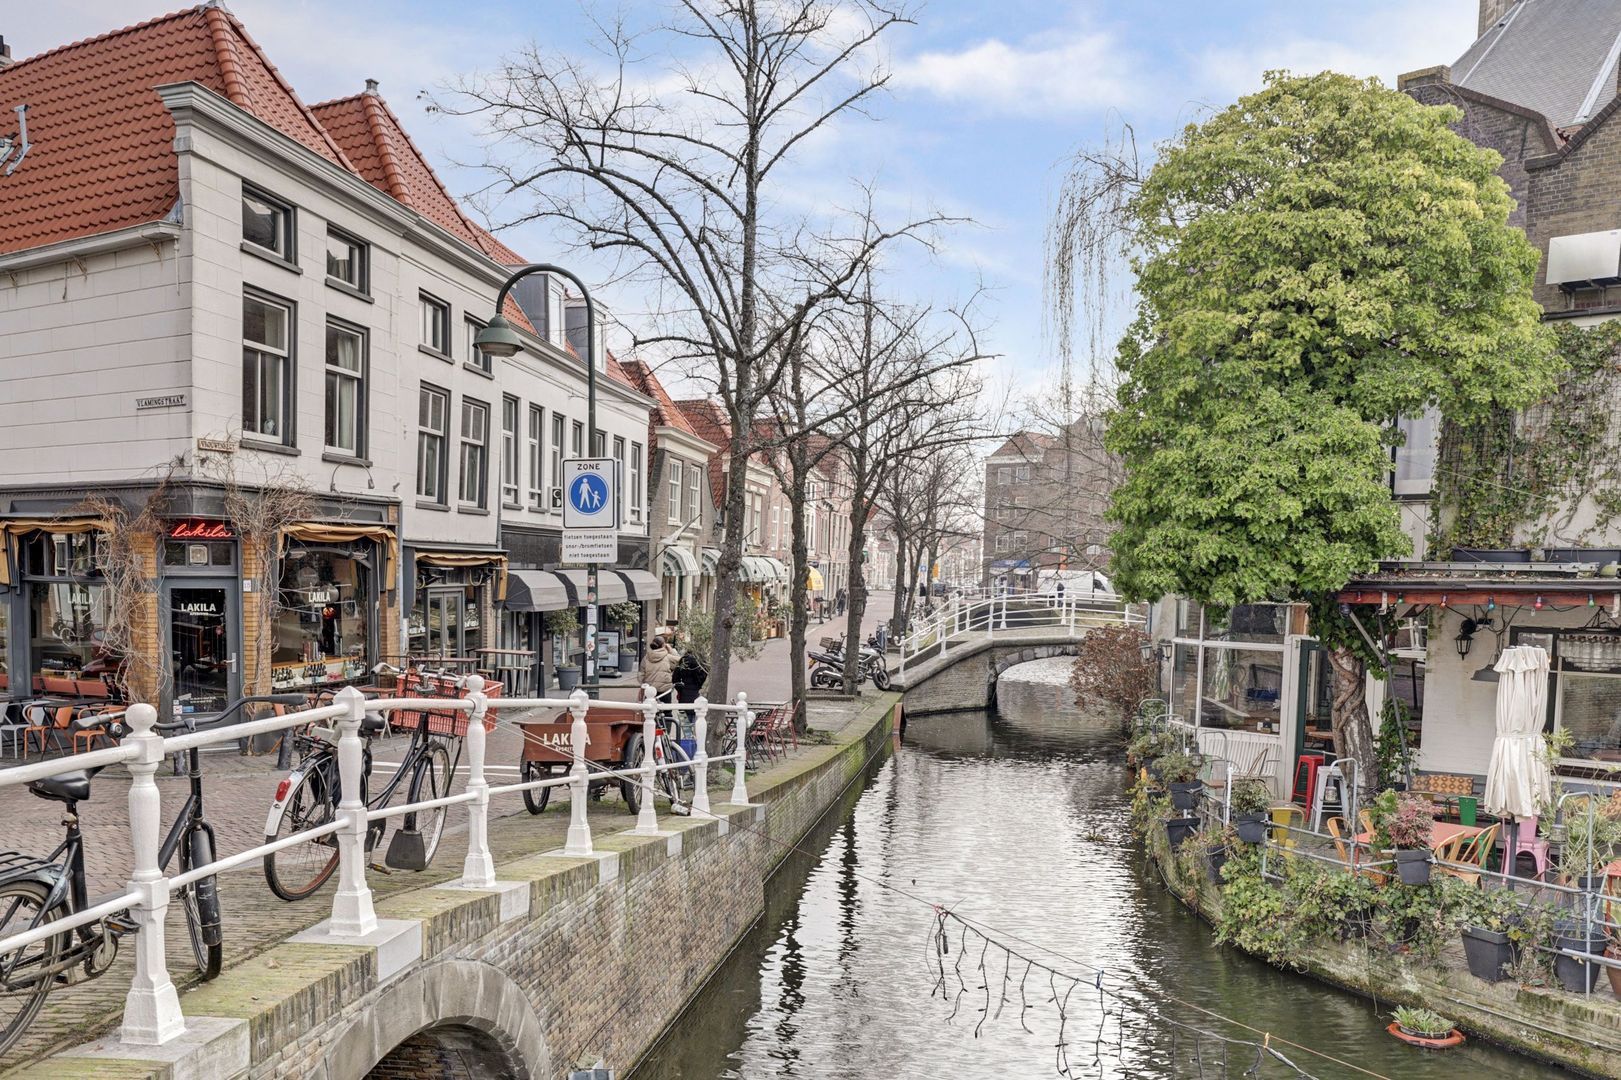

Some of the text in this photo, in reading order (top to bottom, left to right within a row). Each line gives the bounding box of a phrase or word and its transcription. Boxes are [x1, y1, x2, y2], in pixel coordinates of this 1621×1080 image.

[136, 395, 184, 407] VLAMINGSTRAAT
[67, 592, 94, 605] LAKILA
[308, 591, 331, 603] LAKILA
[180, 602, 216, 612] LAKILA
[543, 733, 591, 745] LAKIA
